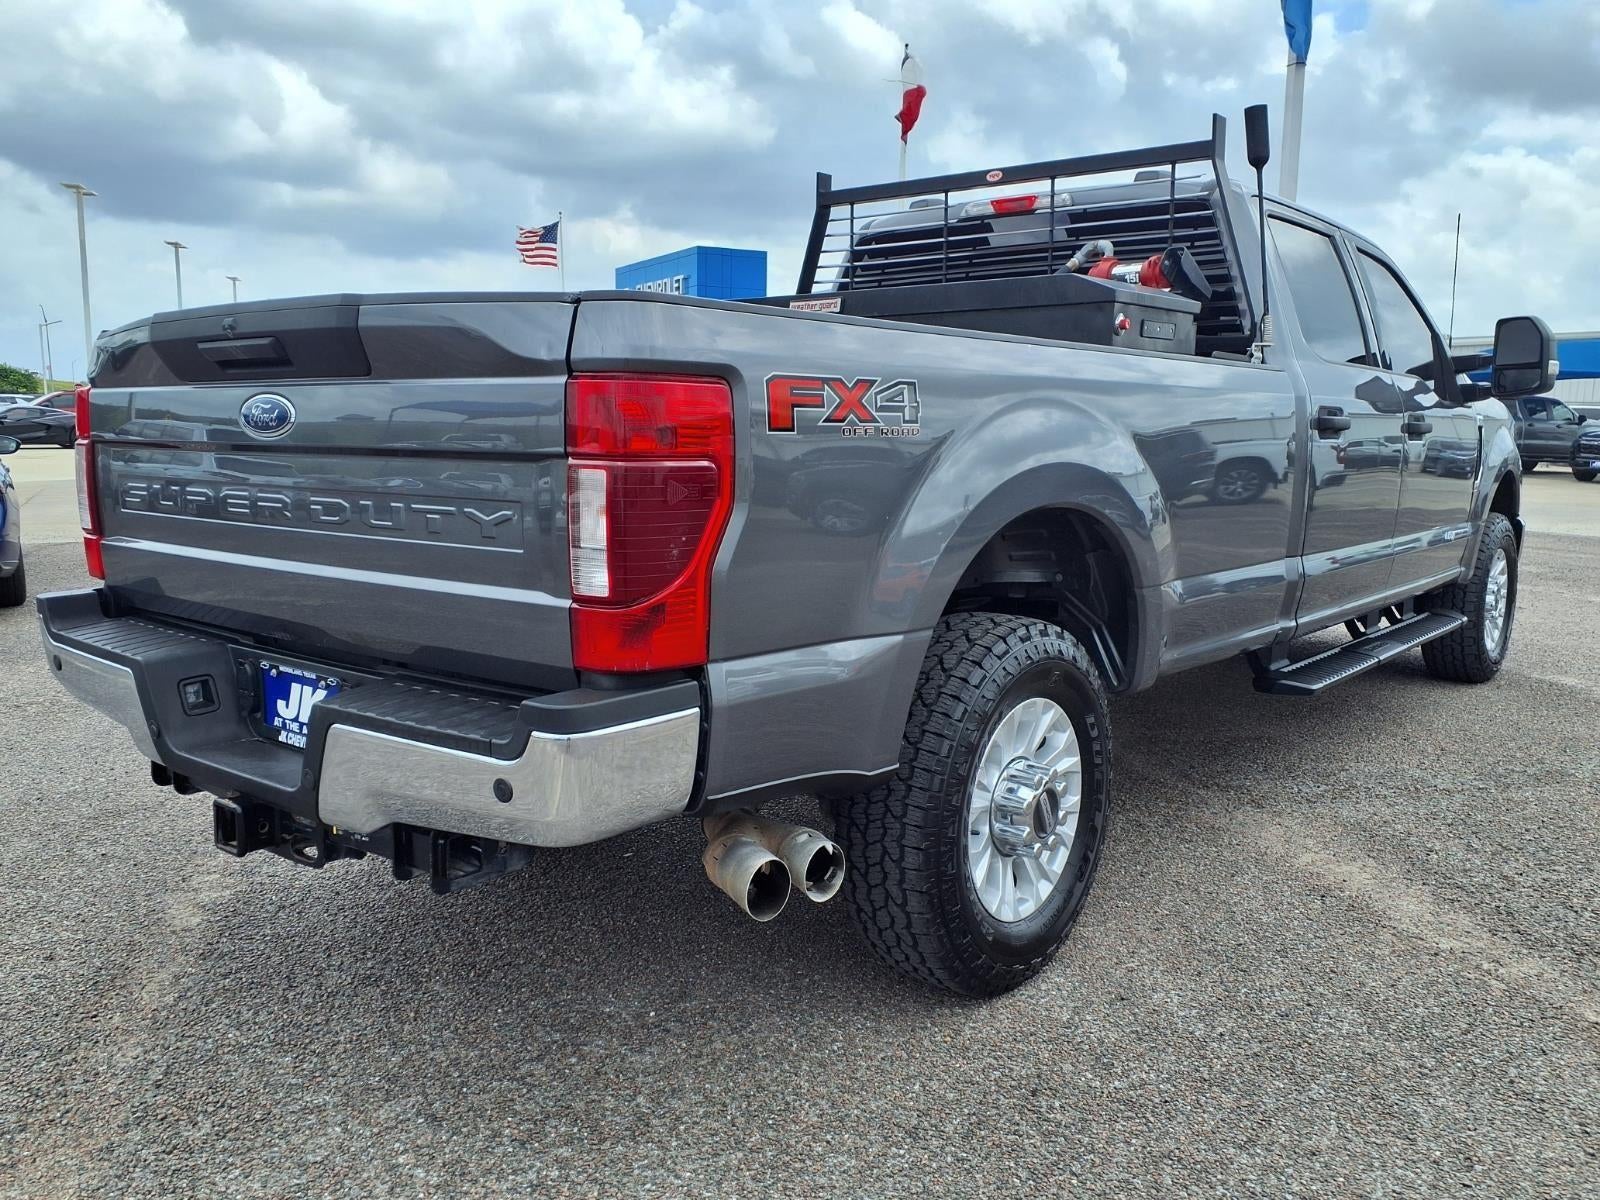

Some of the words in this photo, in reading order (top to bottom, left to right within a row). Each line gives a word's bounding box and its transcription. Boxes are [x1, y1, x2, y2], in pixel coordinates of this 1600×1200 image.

[249, 402, 279, 426] Ford
[764, 372, 921, 434] FX4
[841, 426, 875, 438] OFF
[879, 426, 920, 438] ROAD
[121, 482, 293, 520] SUPER
[309, 497, 516, 539] DUTY
[277, 683, 328, 723] JK
[274, 717, 283, 728] AT
[285, 720, 300, 732] THE
